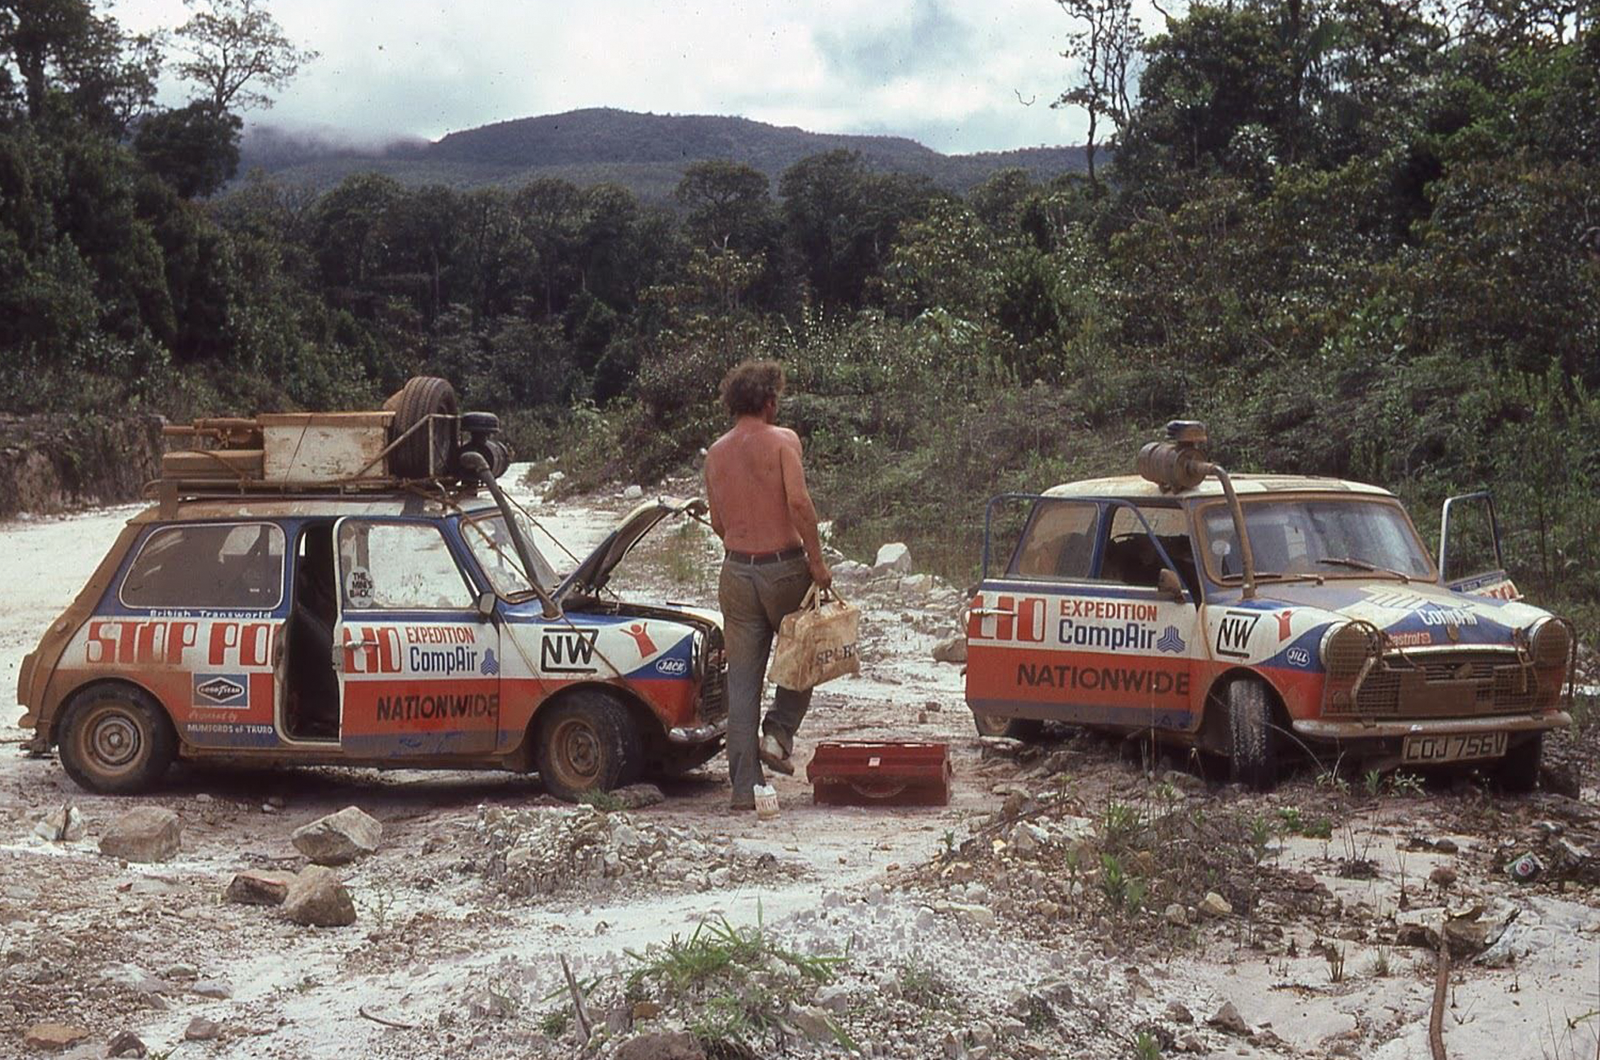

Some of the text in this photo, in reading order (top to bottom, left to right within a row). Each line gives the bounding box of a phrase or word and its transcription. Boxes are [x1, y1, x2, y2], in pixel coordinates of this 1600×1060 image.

[150, 609, 273, 619] British Transworld
[1060, 599, 1157, 622] EXPEDITION
[85, 621, 199, 664] STOP
[405, 627, 476, 644] EXPEDITION
[1058, 618, 1157, 650] CompAir
[1216, 614, 1260, 653] NW
[410, 646, 477, 675] CompAir
[541, 631, 599, 669] NW
[1289, 650, 1307, 662] JILL
[658, 660, 685, 671] JACK
[1016, 664, 1190, 695] NATIONWIDE
[377, 692, 498, 722] NATIONWIDE
[1406, 733, 1507, 760] COJ 756V
